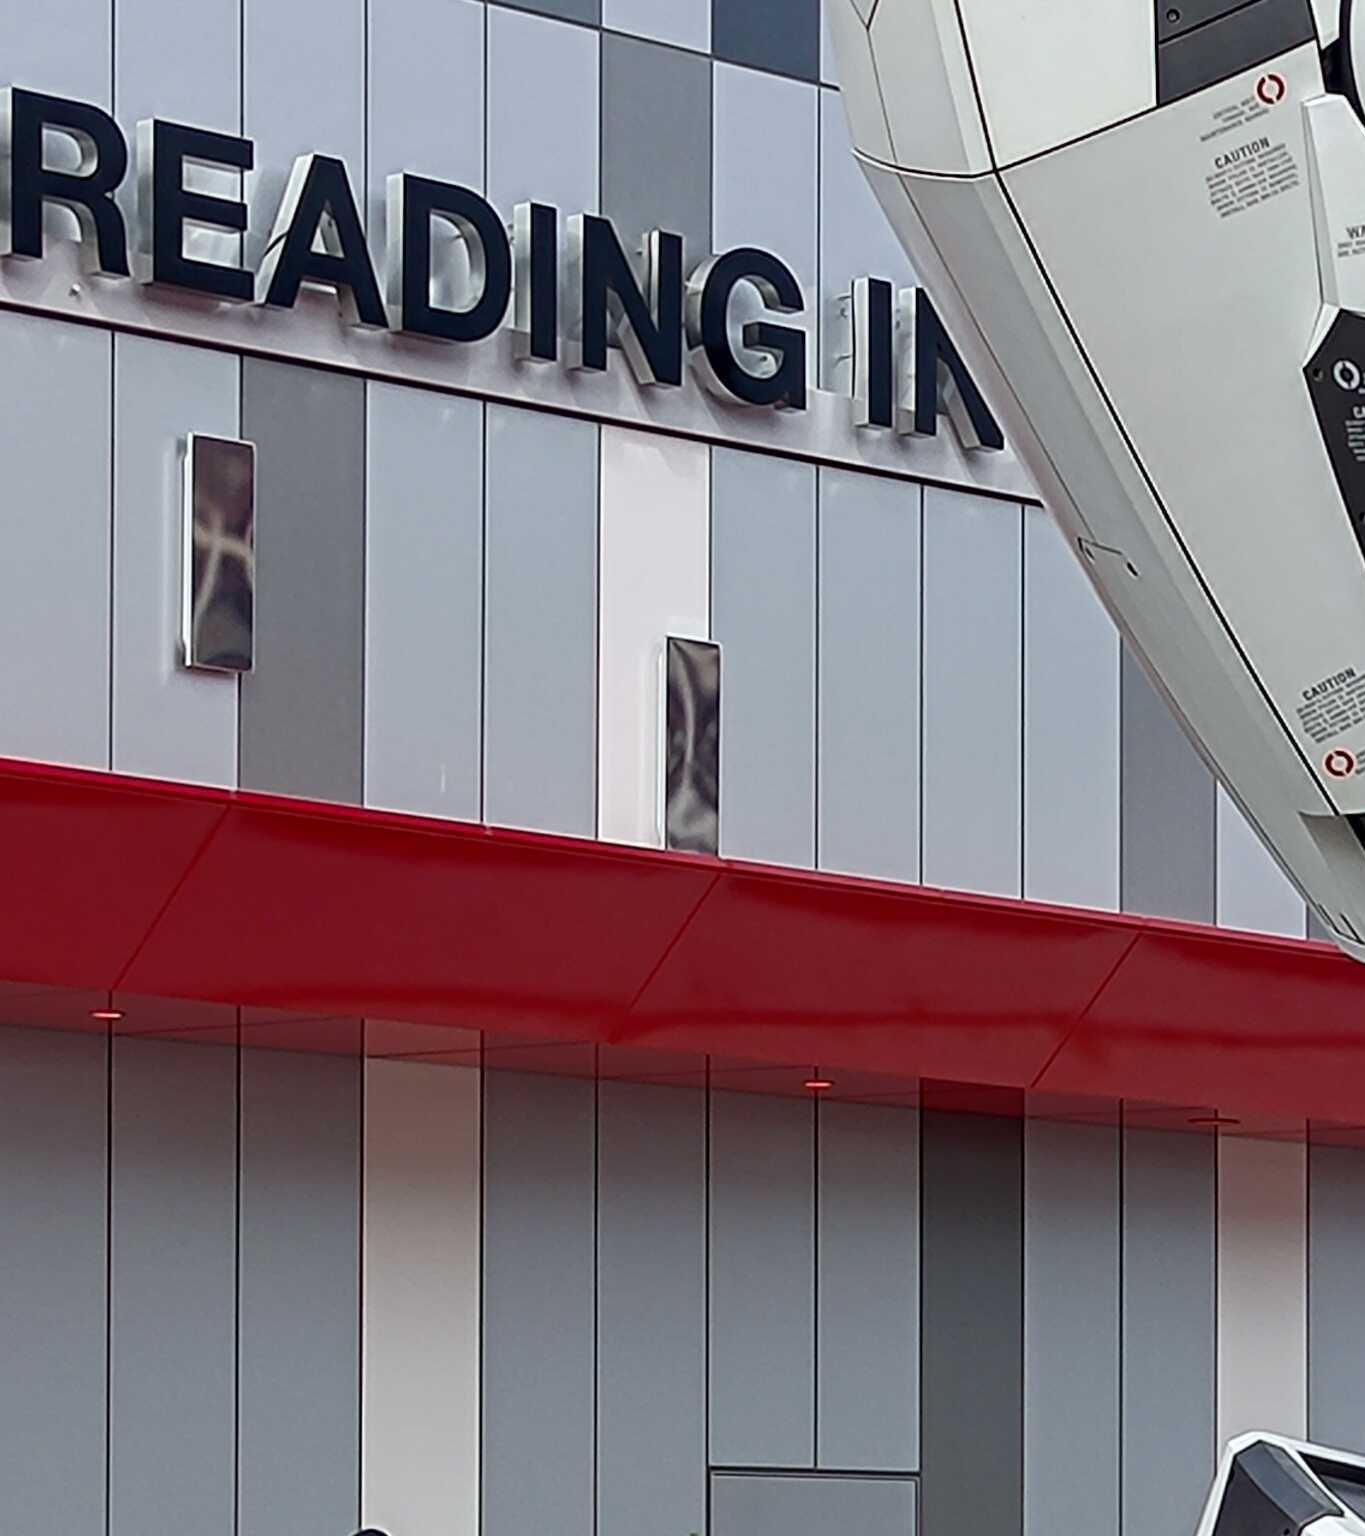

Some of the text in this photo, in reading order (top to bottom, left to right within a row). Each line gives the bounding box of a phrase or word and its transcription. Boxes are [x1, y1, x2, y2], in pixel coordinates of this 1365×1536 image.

[1214, 137, 1271, 169] CAUTION
[8, 84, 807, 412] READING
[1302, 667, 1357, 701] CAUTION
